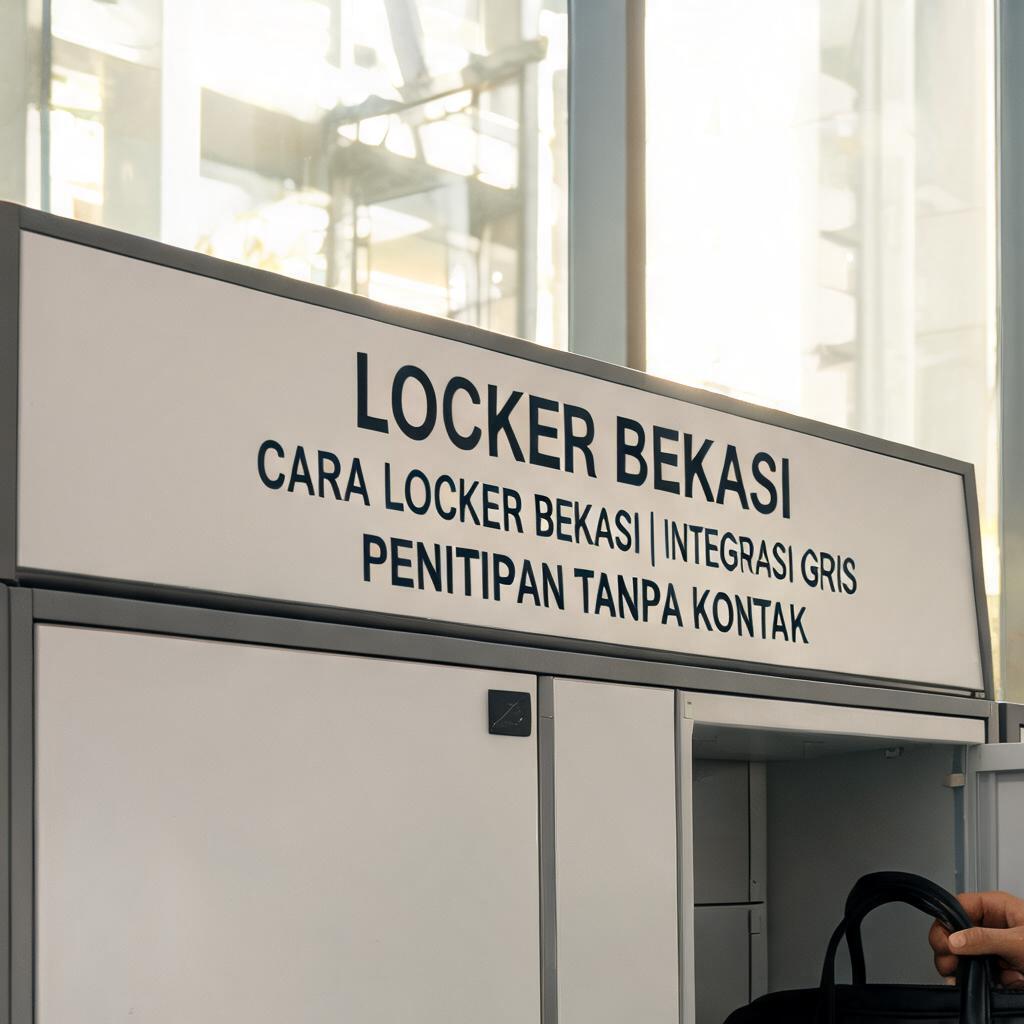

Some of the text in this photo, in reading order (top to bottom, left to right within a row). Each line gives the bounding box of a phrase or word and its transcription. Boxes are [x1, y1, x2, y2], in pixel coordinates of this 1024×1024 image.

[356, 351, 791, 520] LOCKER BEKASI
[257, 439, 371, 507] CARA
[384, 462, 524, 534] LOCKER
[533, 493, 640, 554] BEKASI
[663, 518, 794, 583] INTEGRASI
[800, 548, 858, 595] GRIS
[362, 533, 810, 644] PENITIPAN TANPA KONTAK
